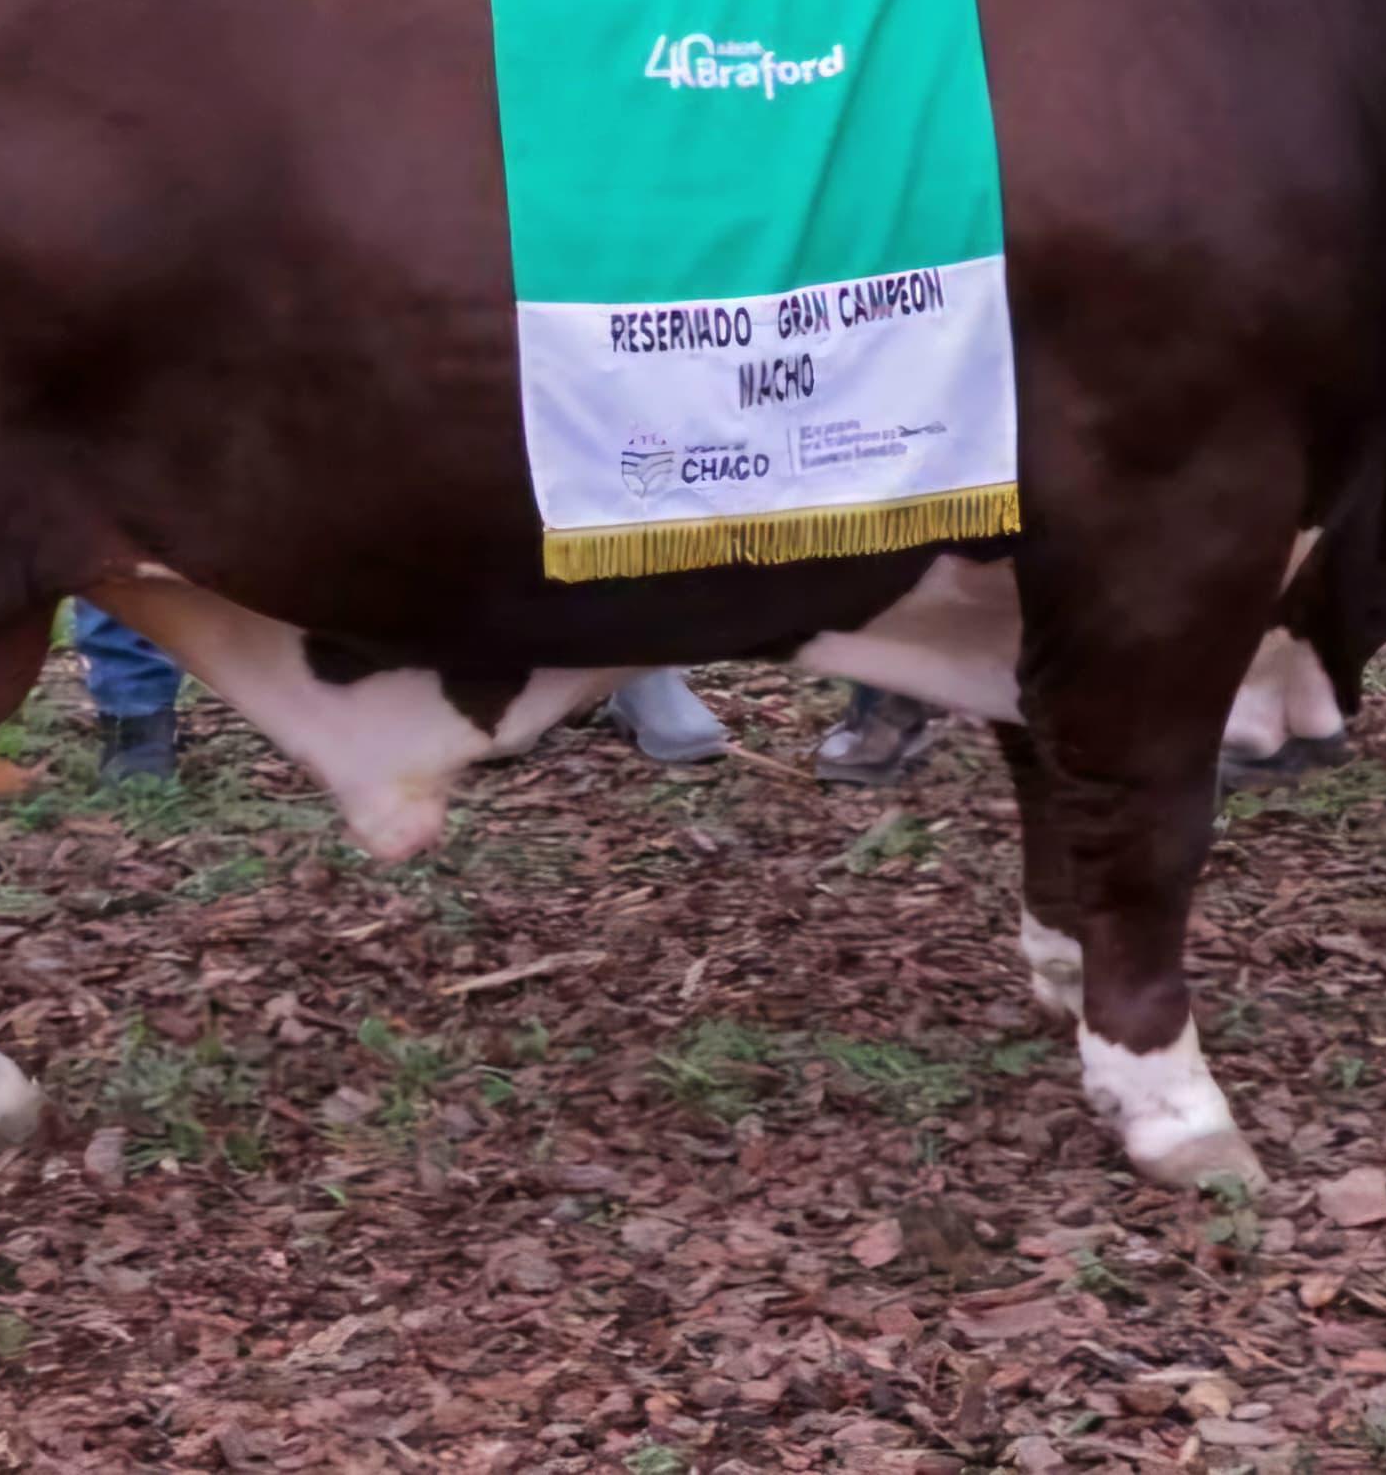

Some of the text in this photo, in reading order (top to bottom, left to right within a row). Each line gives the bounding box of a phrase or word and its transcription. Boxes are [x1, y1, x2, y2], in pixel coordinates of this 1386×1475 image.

[695, 43, 845, 101] Braford
[611, 267, 945, 353] RESERVADO GRAN CAMPEON
[681, 453, 770, 484] CHACO
